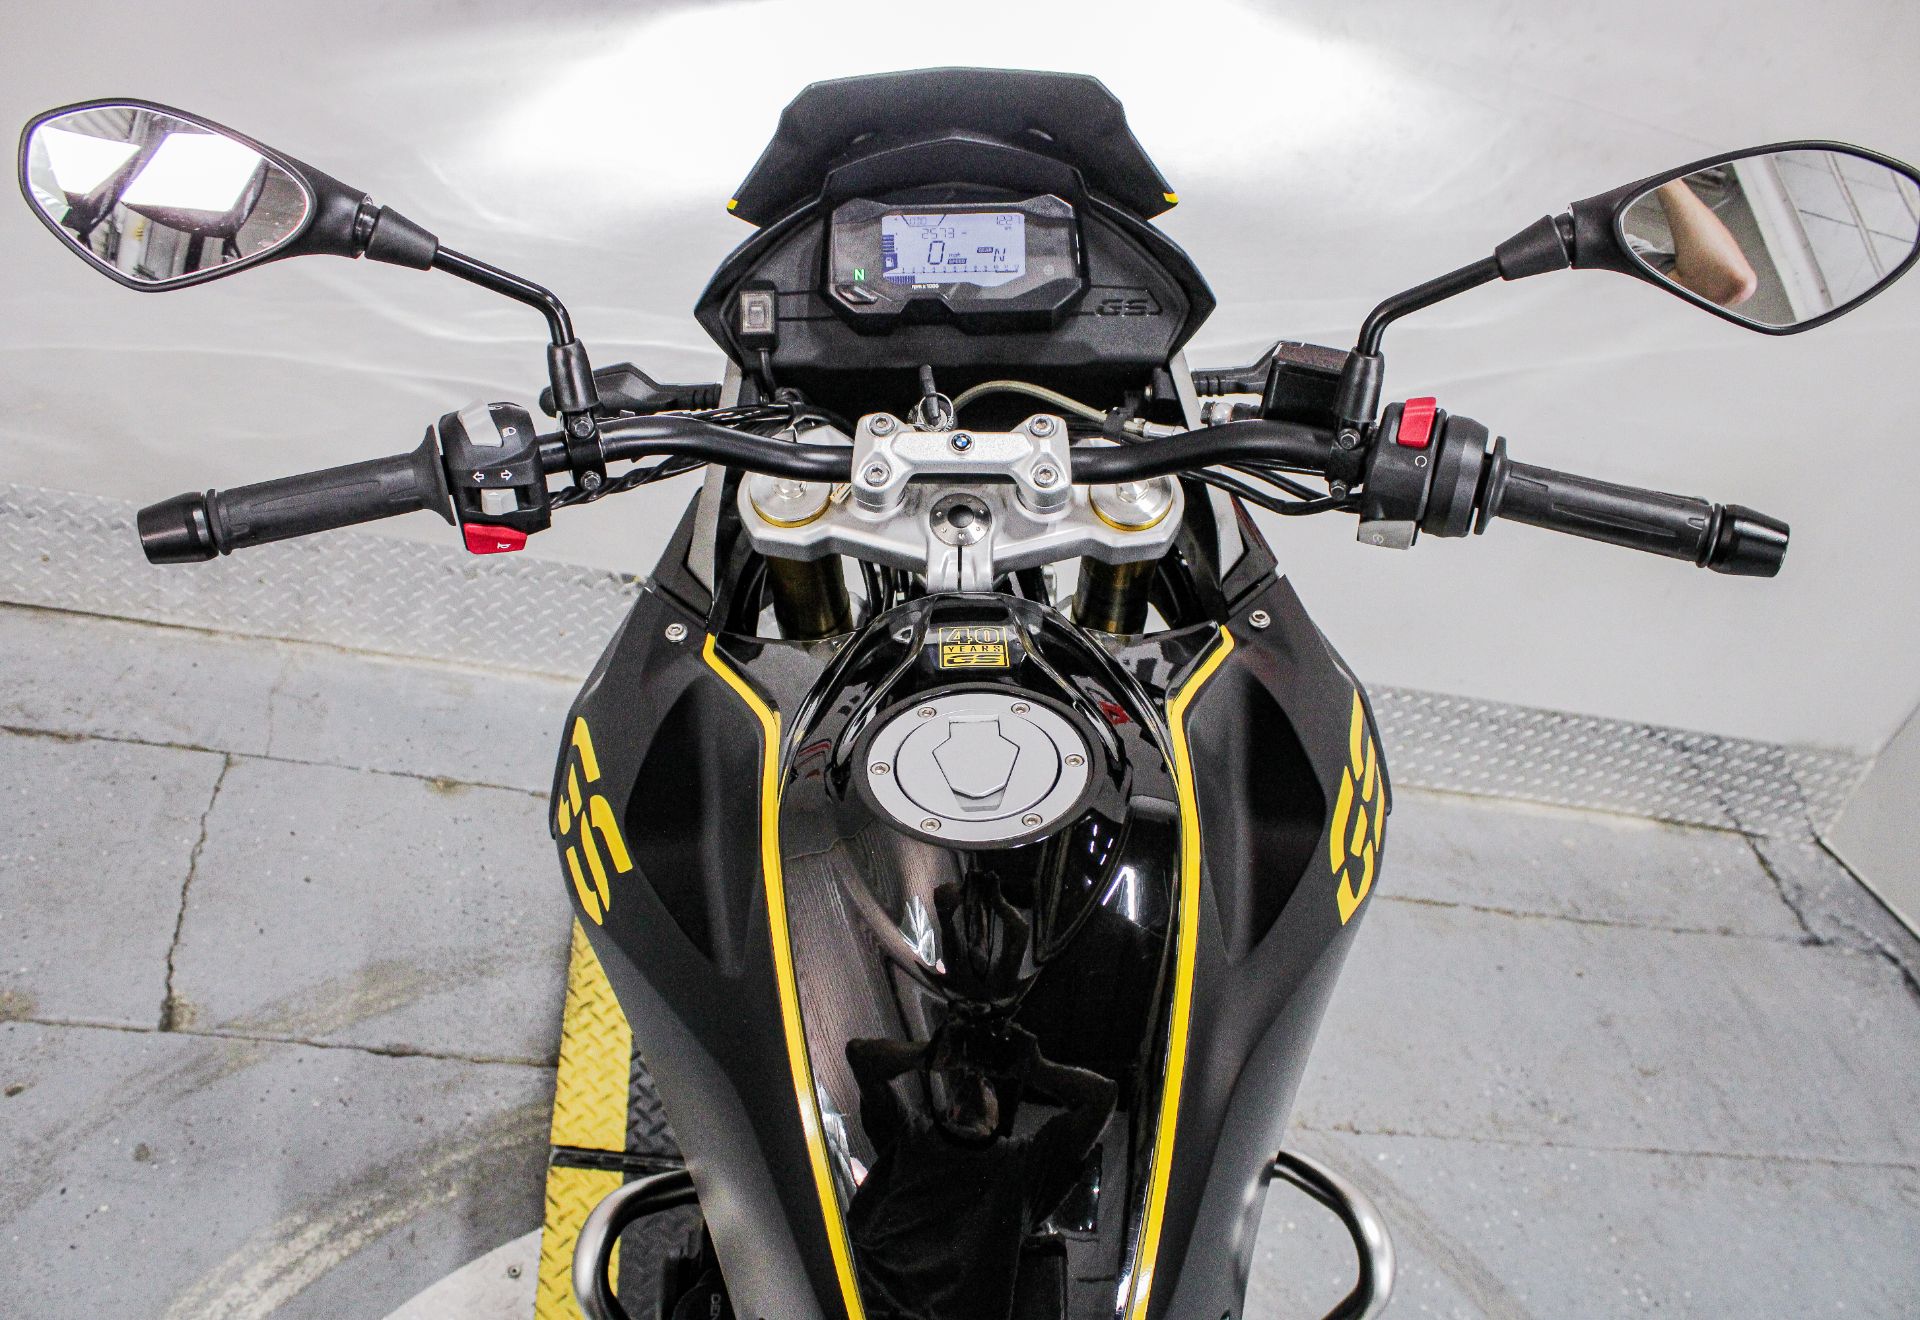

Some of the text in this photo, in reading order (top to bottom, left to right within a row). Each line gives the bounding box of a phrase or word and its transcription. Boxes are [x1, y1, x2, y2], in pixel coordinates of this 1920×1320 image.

[927, 240, 946, 265] 0
[854, 268, 865, 281] N
[1096, 298, 1148, 316] GS
[946, 627, 1000, 644] 40
[946, 654, 1001, 664] GS
